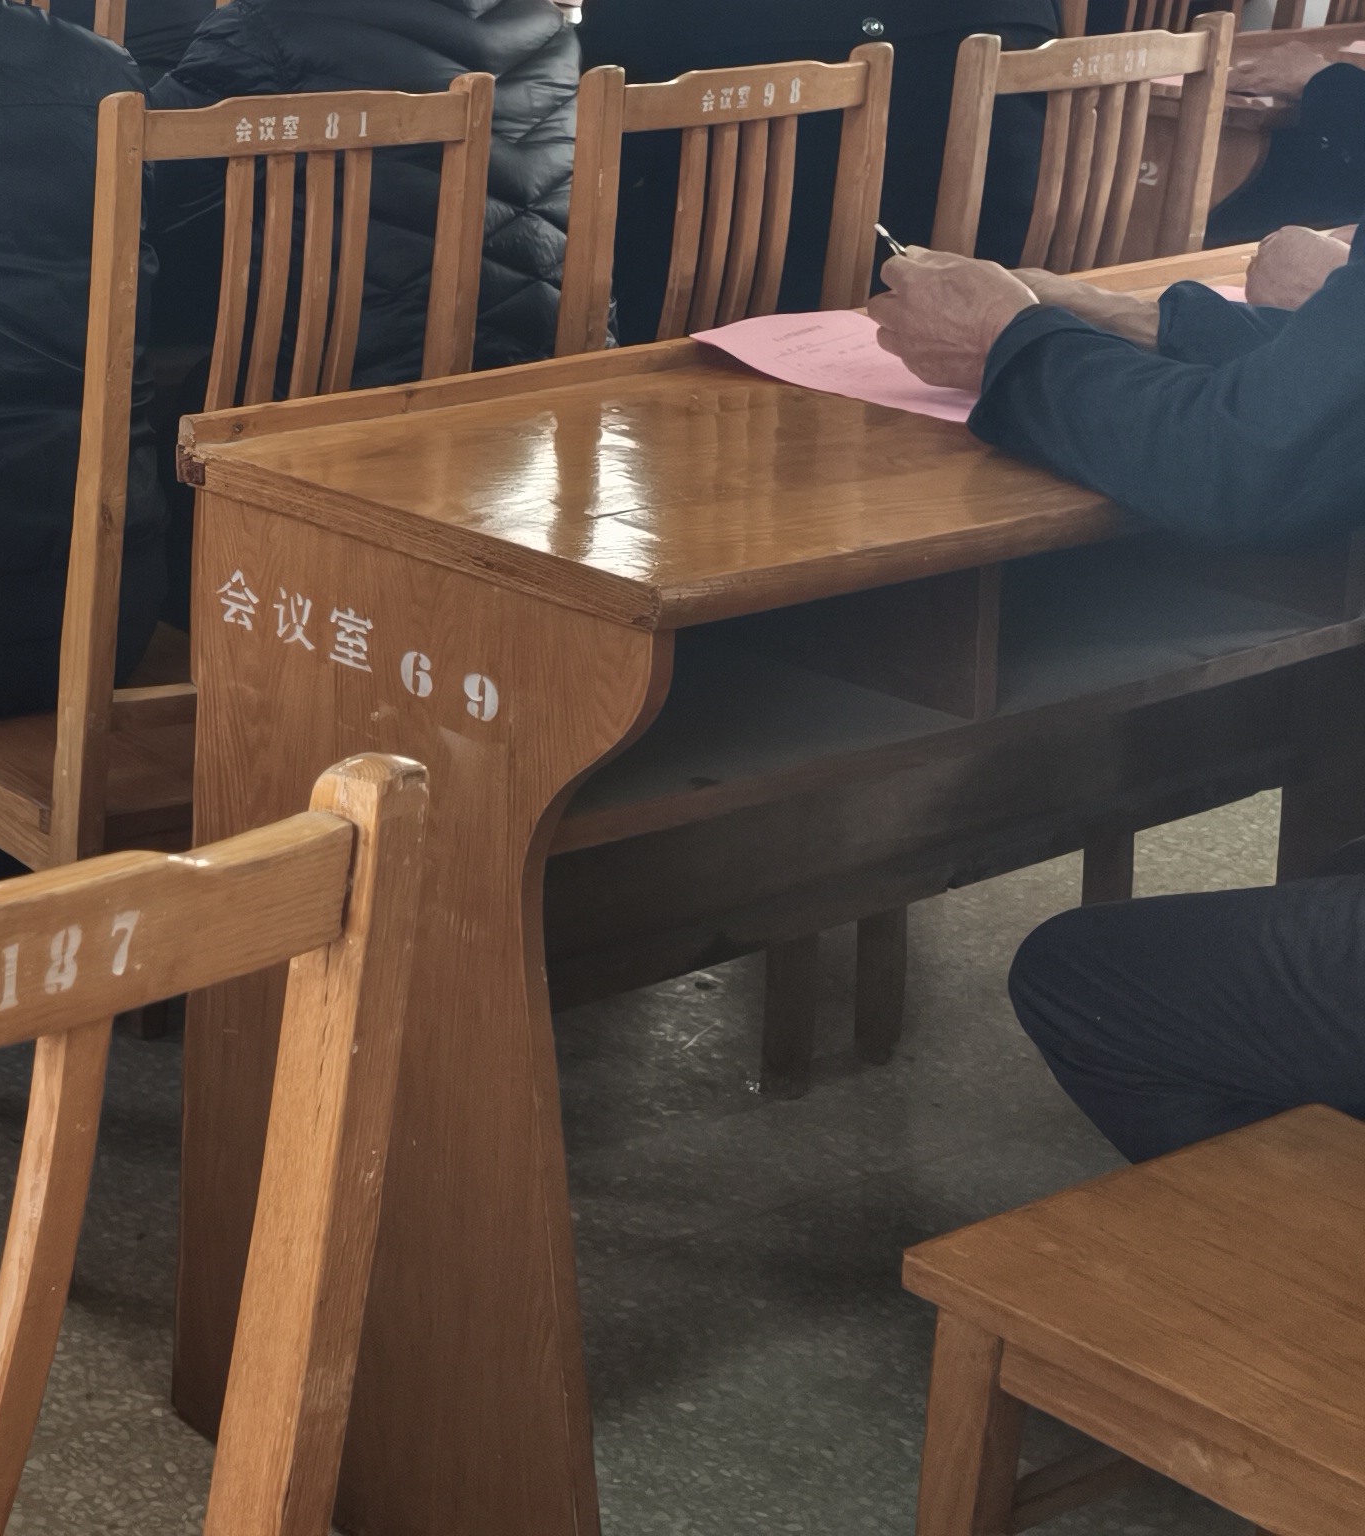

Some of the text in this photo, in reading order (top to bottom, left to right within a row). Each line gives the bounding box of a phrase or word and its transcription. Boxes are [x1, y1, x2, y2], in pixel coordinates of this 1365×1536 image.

[763, 77, 801, 107] 98
[235, 111, 368, 143] 会议室 81
[215, 569, 500, 722] 会议室 69
